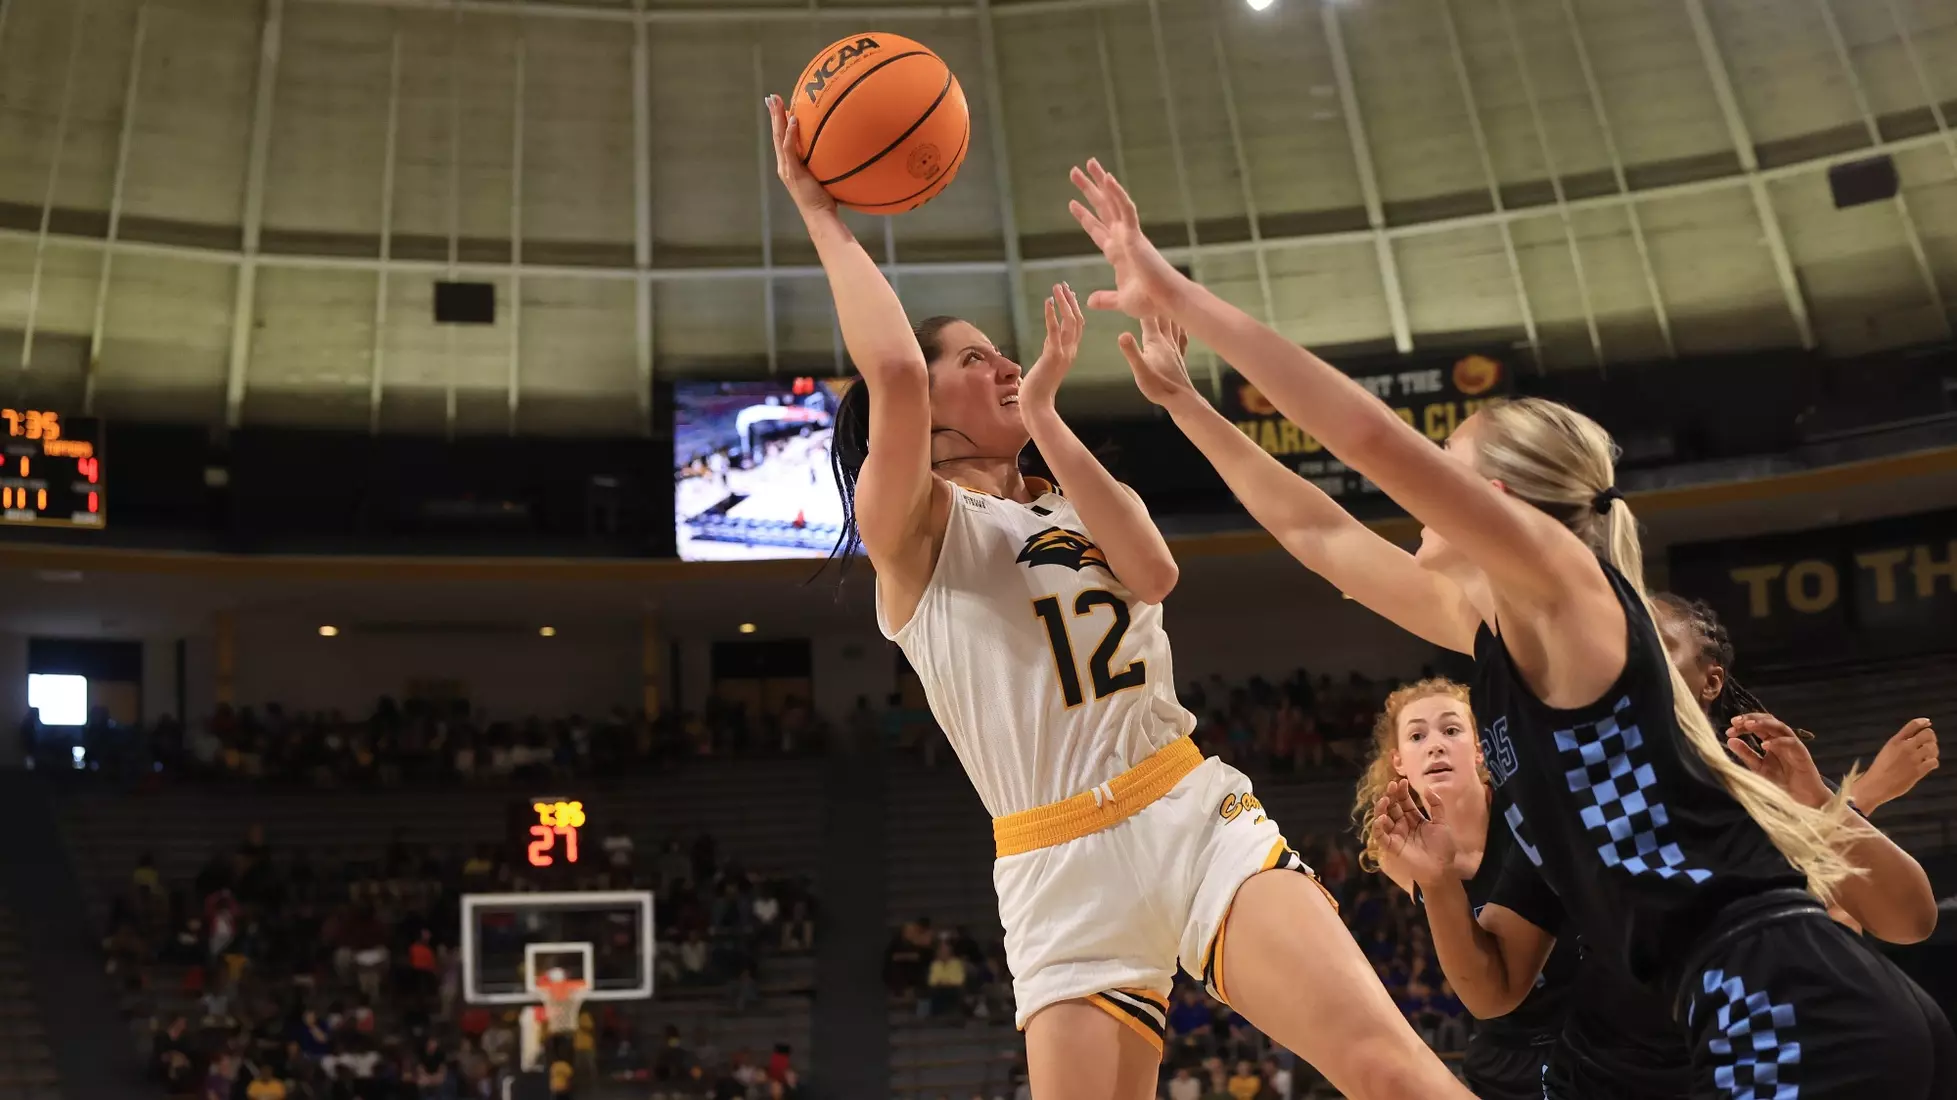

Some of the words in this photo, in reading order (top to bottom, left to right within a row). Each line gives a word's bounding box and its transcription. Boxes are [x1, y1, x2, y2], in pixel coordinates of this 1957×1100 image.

[804, 37, 881, 104] NCAA
[1397, 369, 1443, 396] THE
[1, 408, 60, 440] 7:35
[78, 457, 98, 484] 4
[1729, 560, 1839, 619] TO
[1030, 587, 1147, 711] 12
[528, 825, 578, 866] 27
